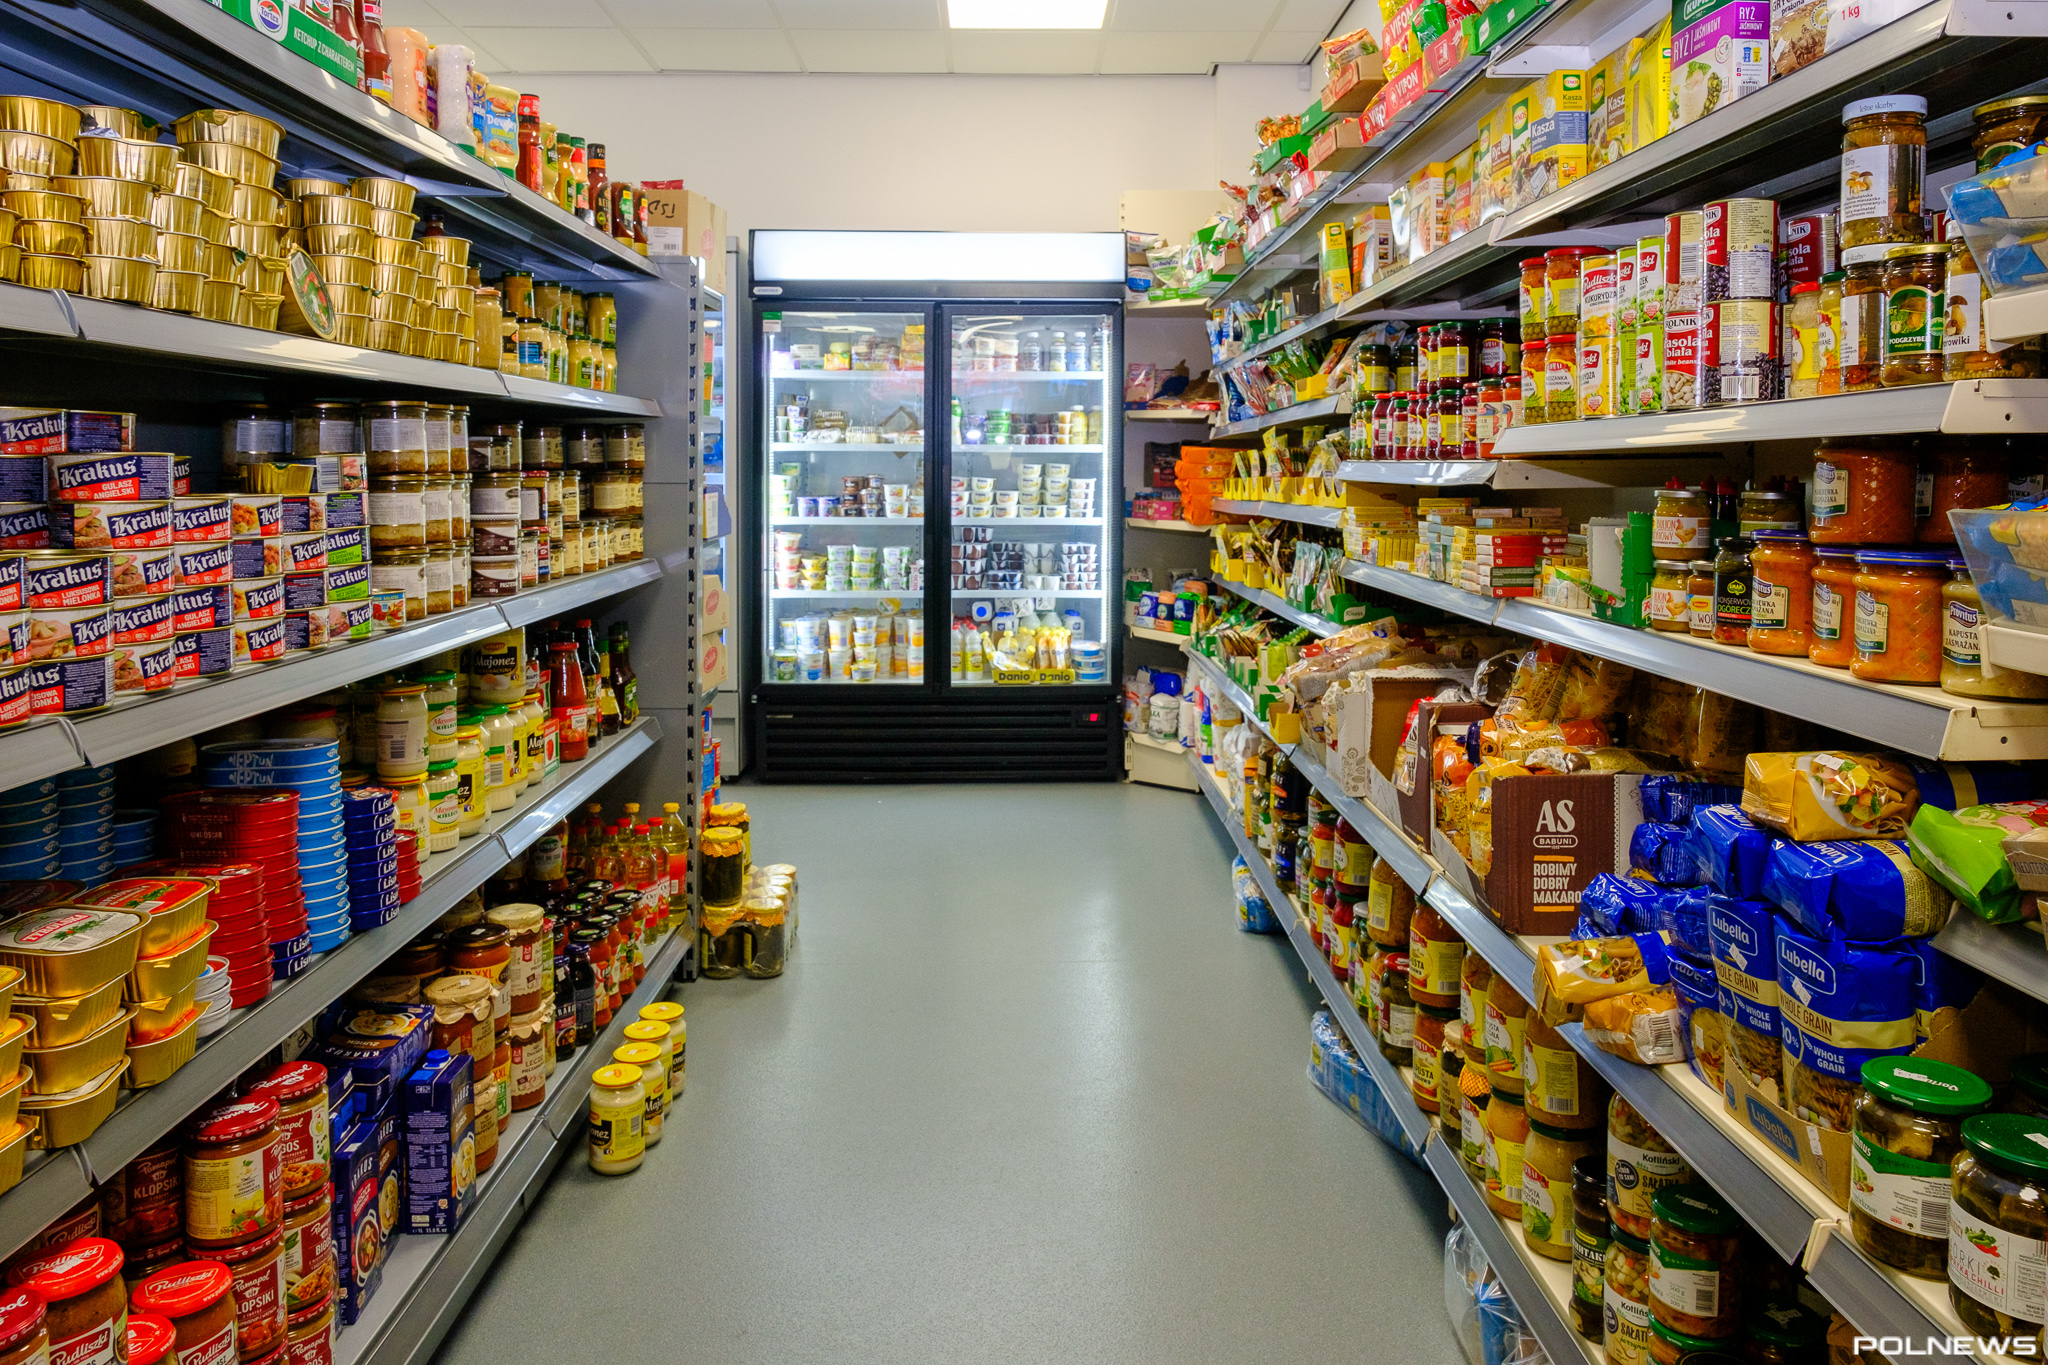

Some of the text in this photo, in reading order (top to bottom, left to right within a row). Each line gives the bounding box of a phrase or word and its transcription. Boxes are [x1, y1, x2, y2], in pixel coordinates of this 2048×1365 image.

[260, 6, 279, 24] Tortex
[1739, 6, 1755, 20] RYŻ
[1842, 4, 1860, 20] 1 kg
[1739, 23, 1763, 31] JAŚMINOWY
[293, 27, 318, 50] KETCHUP
[317, 41, 322, 54] Z
[1673, 16, 1721, 62] RYŻ JAŚMINOWY
[1395, 70, 1419, 98] VIFON
[1608, 93, 1625, 111] Kasz
[1874, 101, 1894, 109] skarby
[1513, 111, 1527, 125] CENOS
[1532, 119, 1555, 139] Kasza
[1584, 272, 1617, 292] Pudliszk
[1666, 318, 1697, 329] ROLNIK
[1889, 336, 1927, 345] PODGRZYBE
[1667, 348, 1692, 357] biała
[60, 458, 137, 488] Krakus
[94, 487, 135, 499] ANGIELSKI
[102, 480, 133, 490] GULASZ
[1657, 519, 1675, 530] BULION
[29, 562, 102, 595] Krakus
[61, 585, 99, 598] LUKSUSOWA
[62, 592, 101, 606] MIELONKA
[1718, 597, 1750, 606] KONSERWOW
[184, 609, 211, 621] GULASZ
[1718, 605, 1750, 615] OGÓRECZ
[1950, 607, 1977, 623] Provitus
[177, 616, 212, 629] ANGIELSKI
[1949, 628, 1978, 640] KAPUSTA
[1945, 638, 1979, 651] ZASMAŻAN
[474, 655, 516, 672] Majonez
[999, 670, 1031, 682] Danio
[1039, 671, 1071, 683] Danio
[1536, 800, 1576, 833] AS
[1533, 863, 1577, 876] ROBIMY
[1533, 877, 1569, 890] DOBRY
[1533, 890, 1582, 904] MAKARO
[1712, 912, 1750, 945] Lubella
[1781, 942, 1825, 983] Lubella
[1717, 965, 1759, 995] HOLE GRAIN
[1746, 1005, 1770, 1022] WHOLE
[1750, 1016, 1772, 1031] GRAIN
[1803, 1010, 1832, 1036] GRAIN
[1782, 1021, 1799, 1048] 00%
[1813, 1046, 1844, 1064] WHOLE
[1817, 1058, 1845, 1074] GRAIN
[1751, 1102, 1793, 1151] Lubella
[1642, 1153, 1680, 1165] Kotliński
[149, 1270, 213, 1292] Pudliszki
[1971, 1273, 2004, 1296] CHILLI
[236, 1290, 274, 1314] LOPSIKI
[1620, 1301, 1648, 1317] Kotlińs
[1620, 1322, 1646, 1342] SAŁAT
